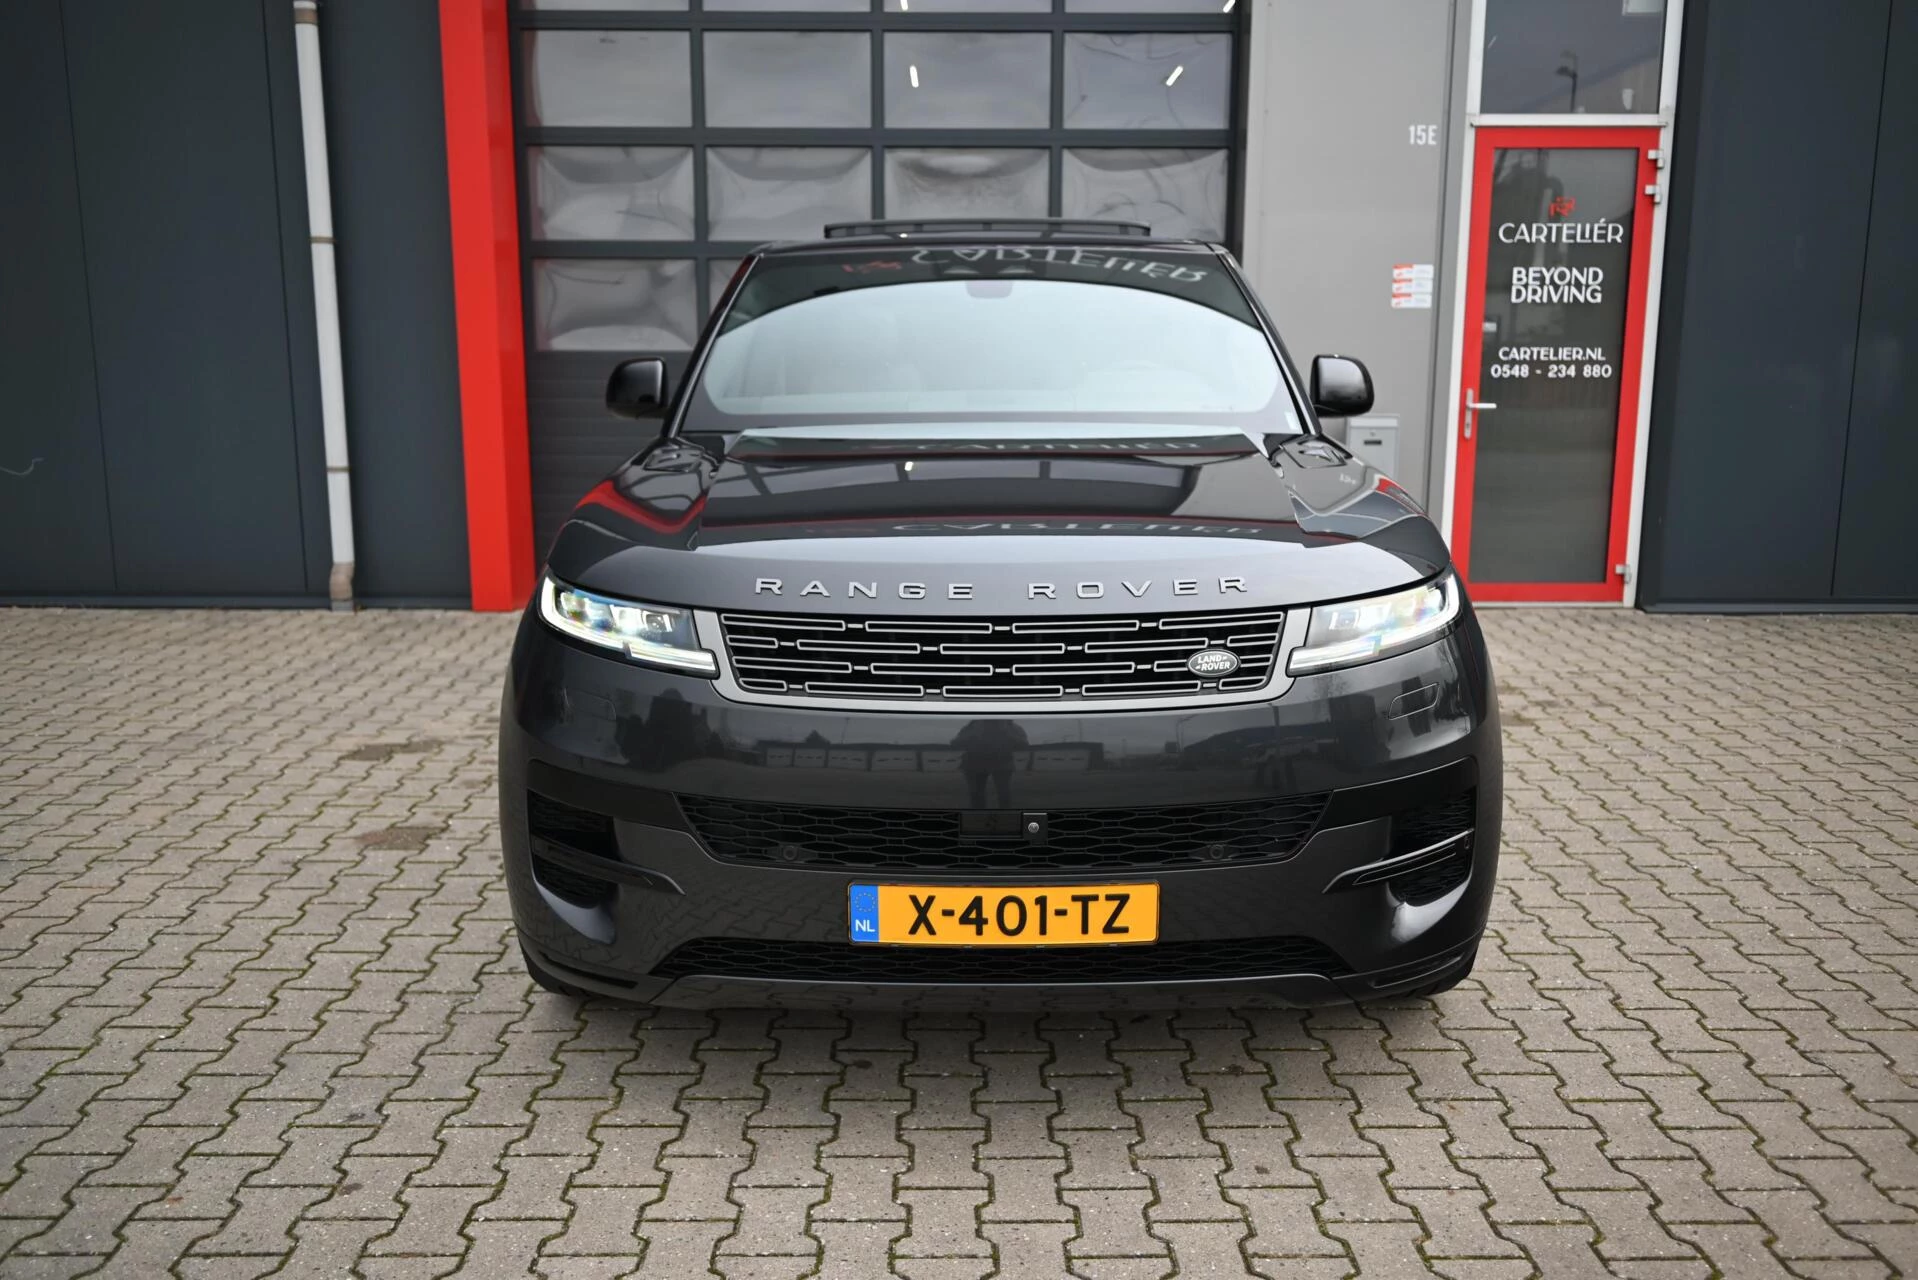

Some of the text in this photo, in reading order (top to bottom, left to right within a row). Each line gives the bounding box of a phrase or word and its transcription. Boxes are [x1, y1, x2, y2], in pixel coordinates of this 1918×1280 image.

[1408, 124, 1437, 145] 15E
[1512, 267, 1603, 285] BEYOND
[1511, 285, 1602, 304] DRIVING
[1498, 347, 1606, 361] CARTELIER.NL
[1490, 364, 1529, 378] 0548
[1547, 364, 1576, 378] 234
[1583, 364, 1612, 378] 880
[755, 575, 1249, 600] RANGE ROVER
[908, 893, 1131, 937] X-401-TZ
[854, 919, 875, 933] NL
